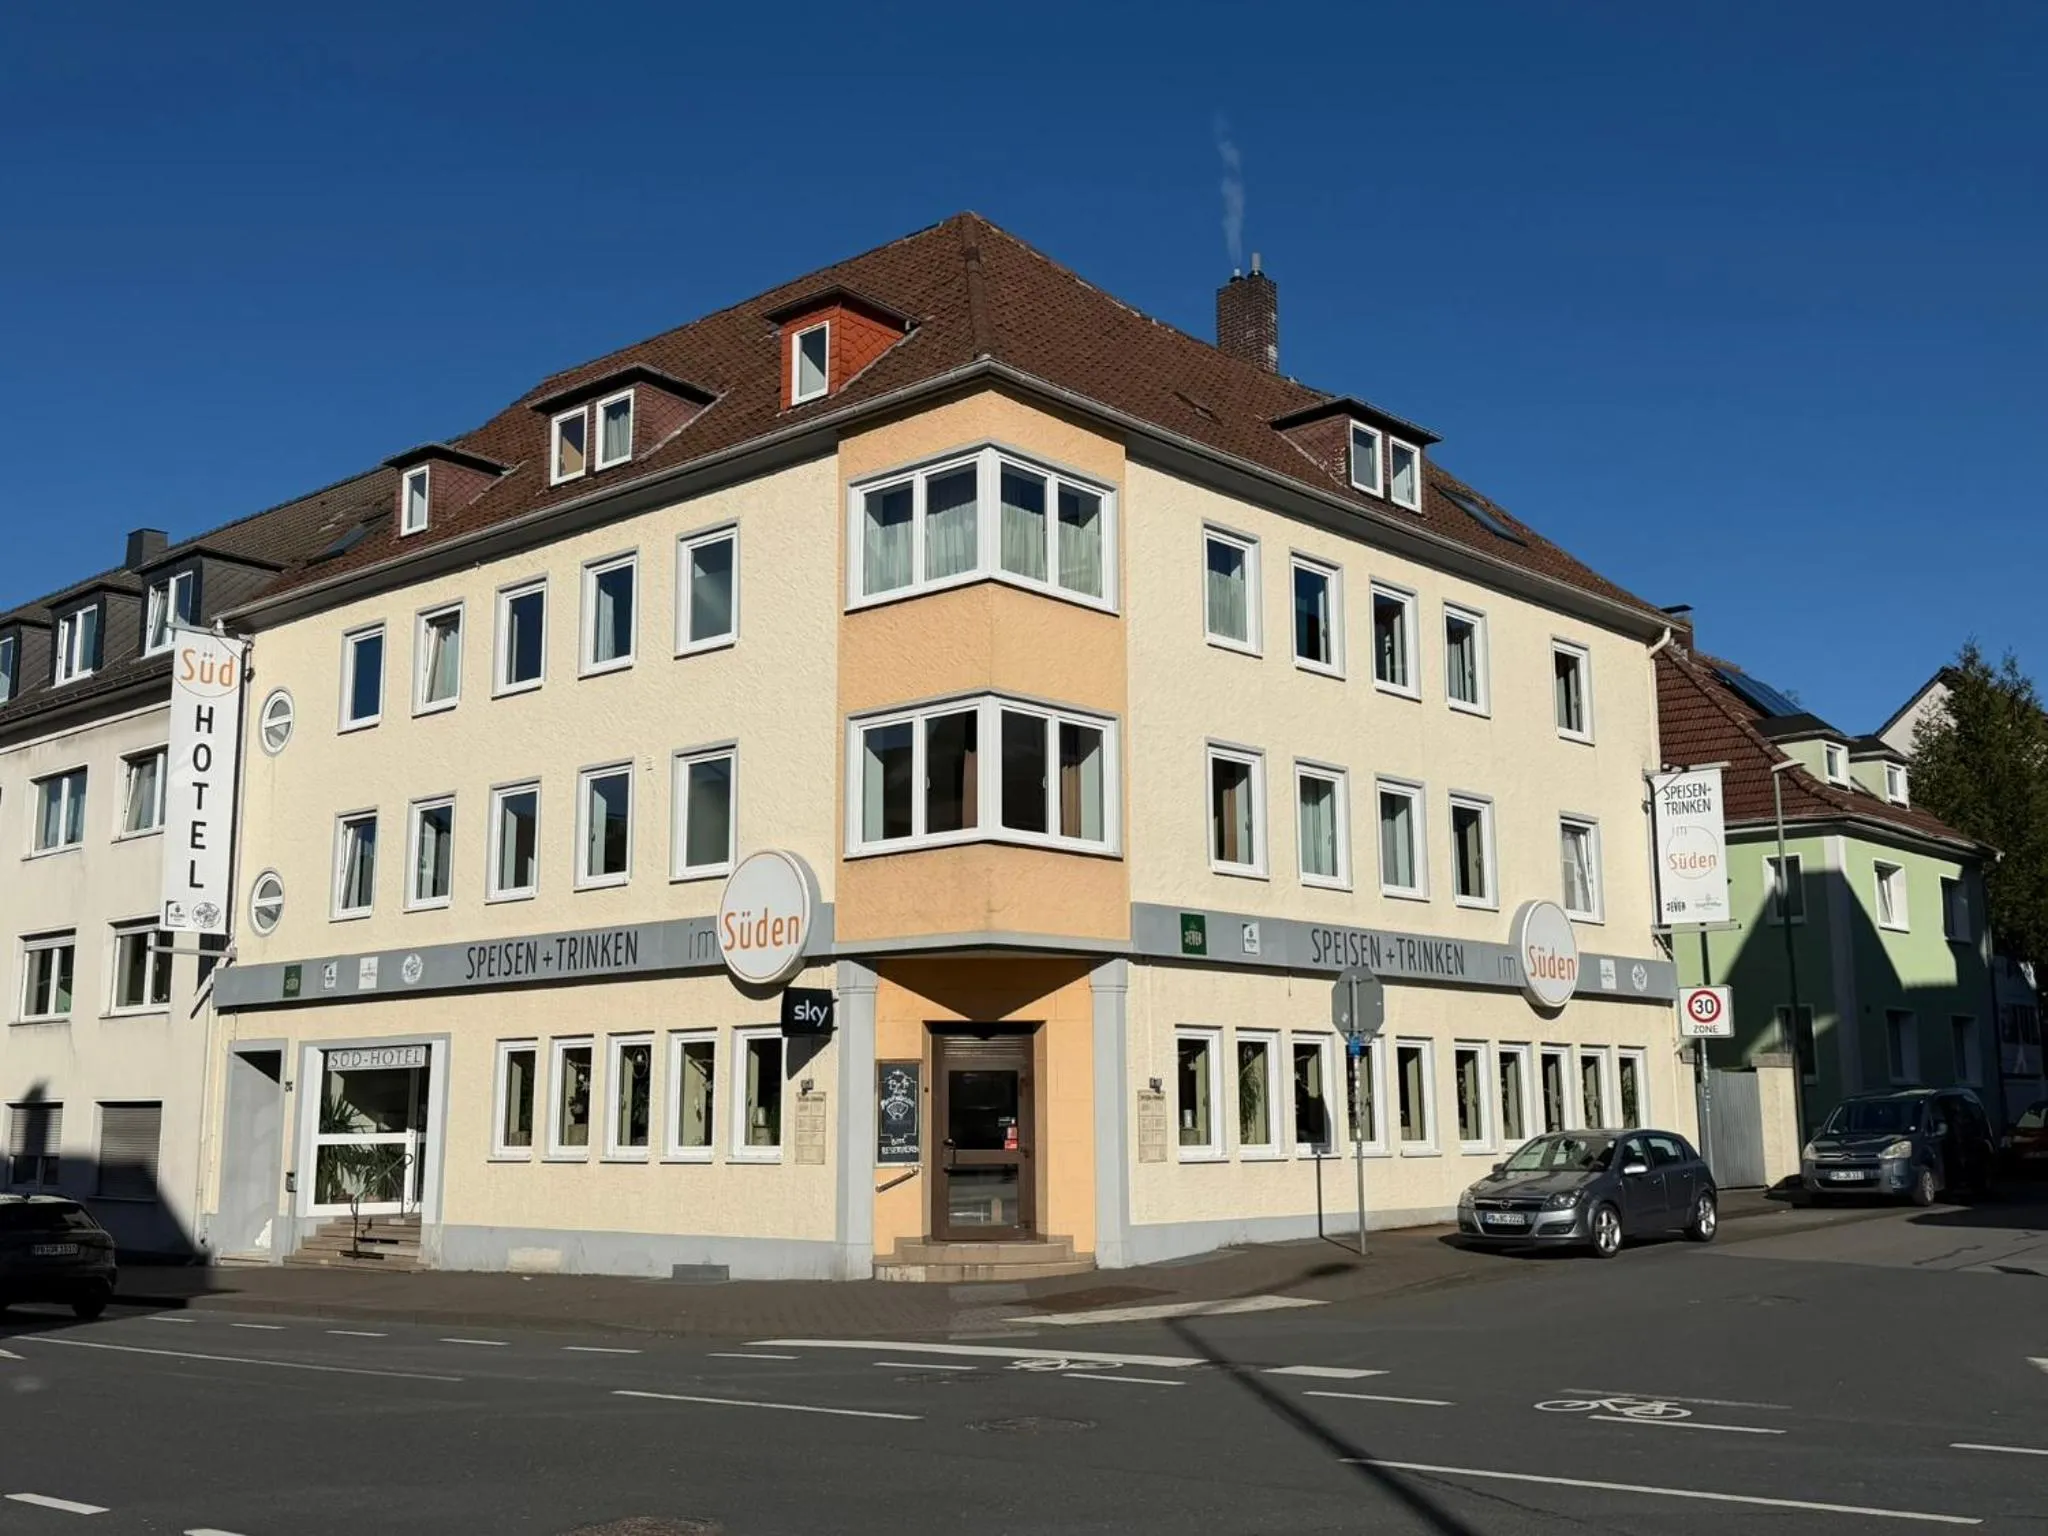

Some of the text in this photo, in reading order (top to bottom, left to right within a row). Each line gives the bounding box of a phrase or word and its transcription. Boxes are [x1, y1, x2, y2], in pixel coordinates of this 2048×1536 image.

[180, 647, 234, 687] Süd
[189, 704, 214, 889] HOTEL
[1663, 798, 1712, 816] TRINKEN
[1665, 851, 1718, 870] Süden
[465, 940, 538, 980] SPEISEN
[555, 929, 639, 972] TRINKEN
[688, 920, 717, 961] im
[723, 906, 800, 951] Süden
[1311, 928, 1382, 969] SPEISEN
[1396, 937, 1465, 976] TRINKEN
[1528, 944, 1577, 981] Süden
[793, 999, 829, 1027] sky
[1694, 998, 1715, 1015] 30
[1693, 1024, 1720, 1034] ZONE
